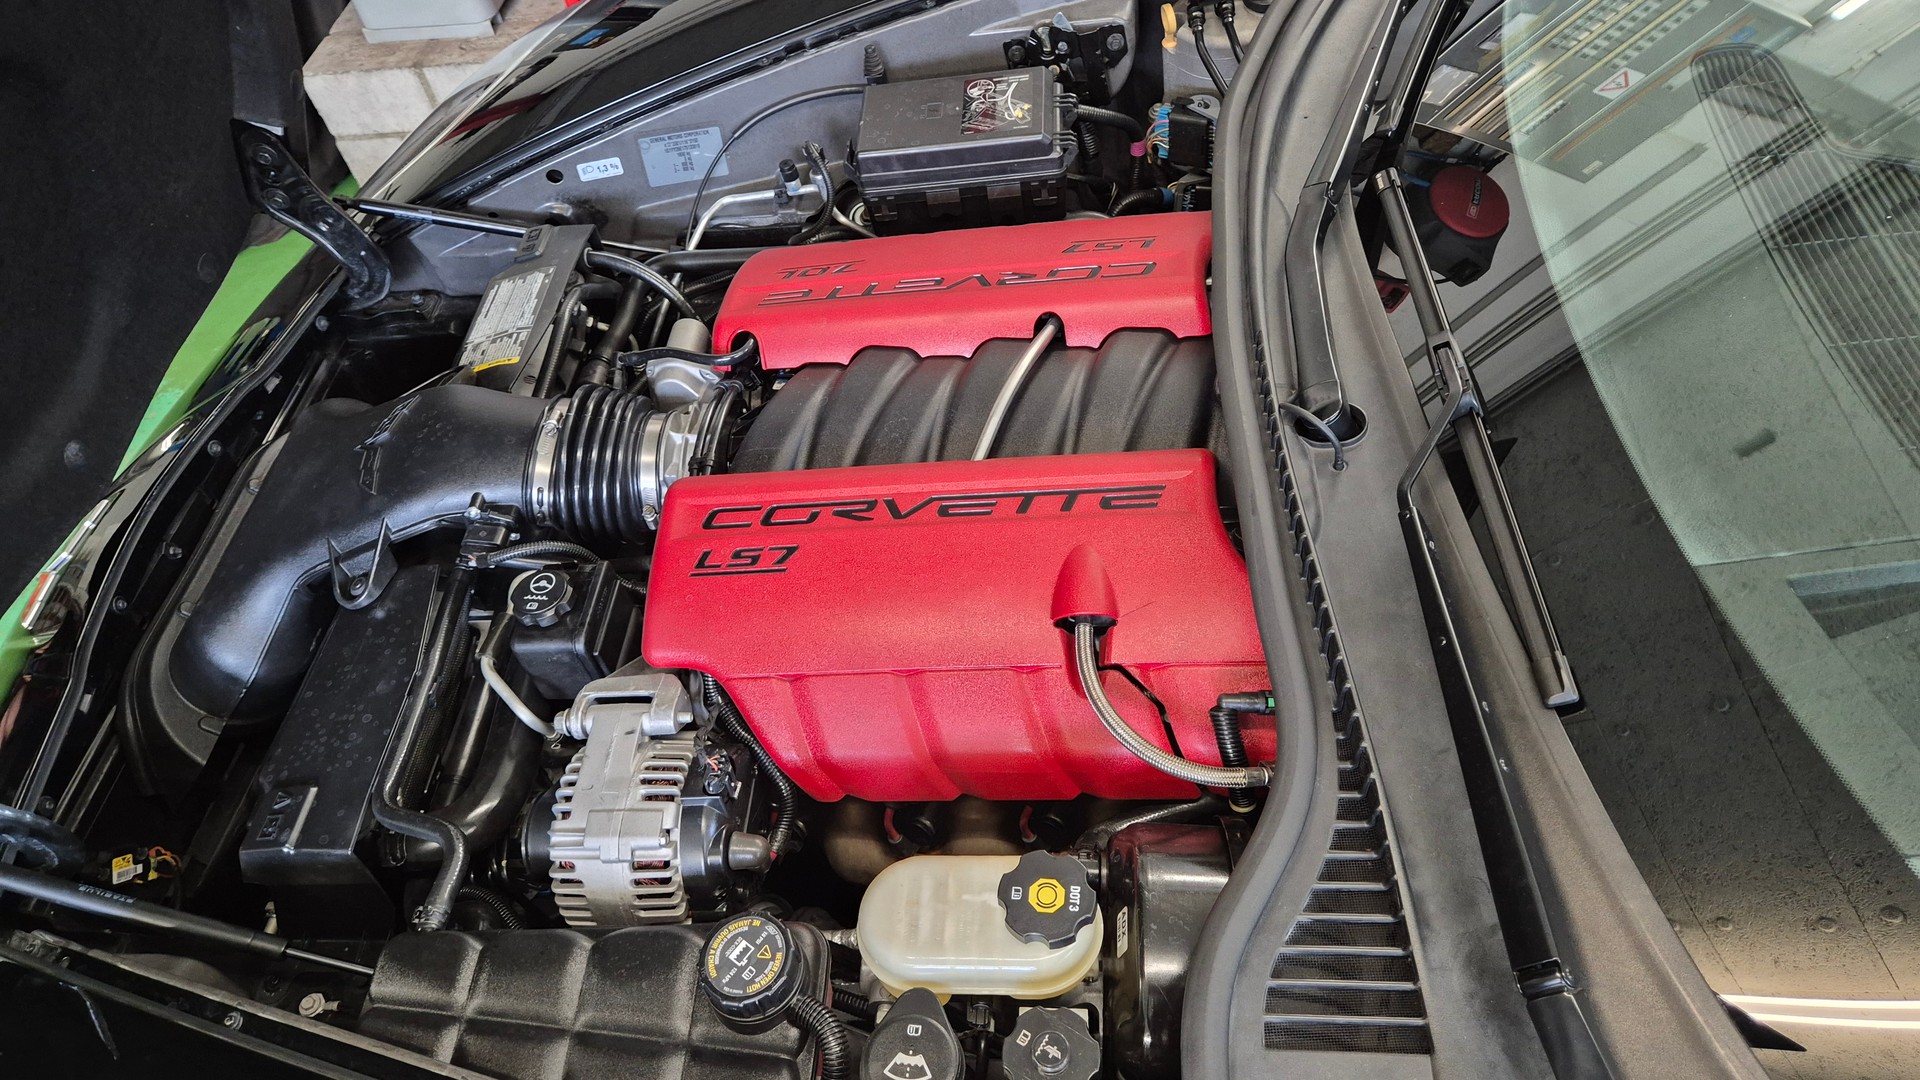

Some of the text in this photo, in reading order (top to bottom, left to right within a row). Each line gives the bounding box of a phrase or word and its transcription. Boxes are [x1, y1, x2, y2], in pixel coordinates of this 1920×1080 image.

[684, 130, 710, 138] CORPORATION
[597, 164, 608, 174] 1,3
[1062, 237, 1156, 253] LS7
[758, 261, 1157, 306] CORVETTE
[702, 484, 1166, 530] CORVETTE
[693, 545, 800, 569] LS7
[1069, 885, 1081, 912] DOT 3
[729, 919, 751, 932] JAMAIS
[711, 929, 729, 949] OUVRIR
[762, 969, 775, 986] OPEN
[746, 983, 761, 993] HOT!
